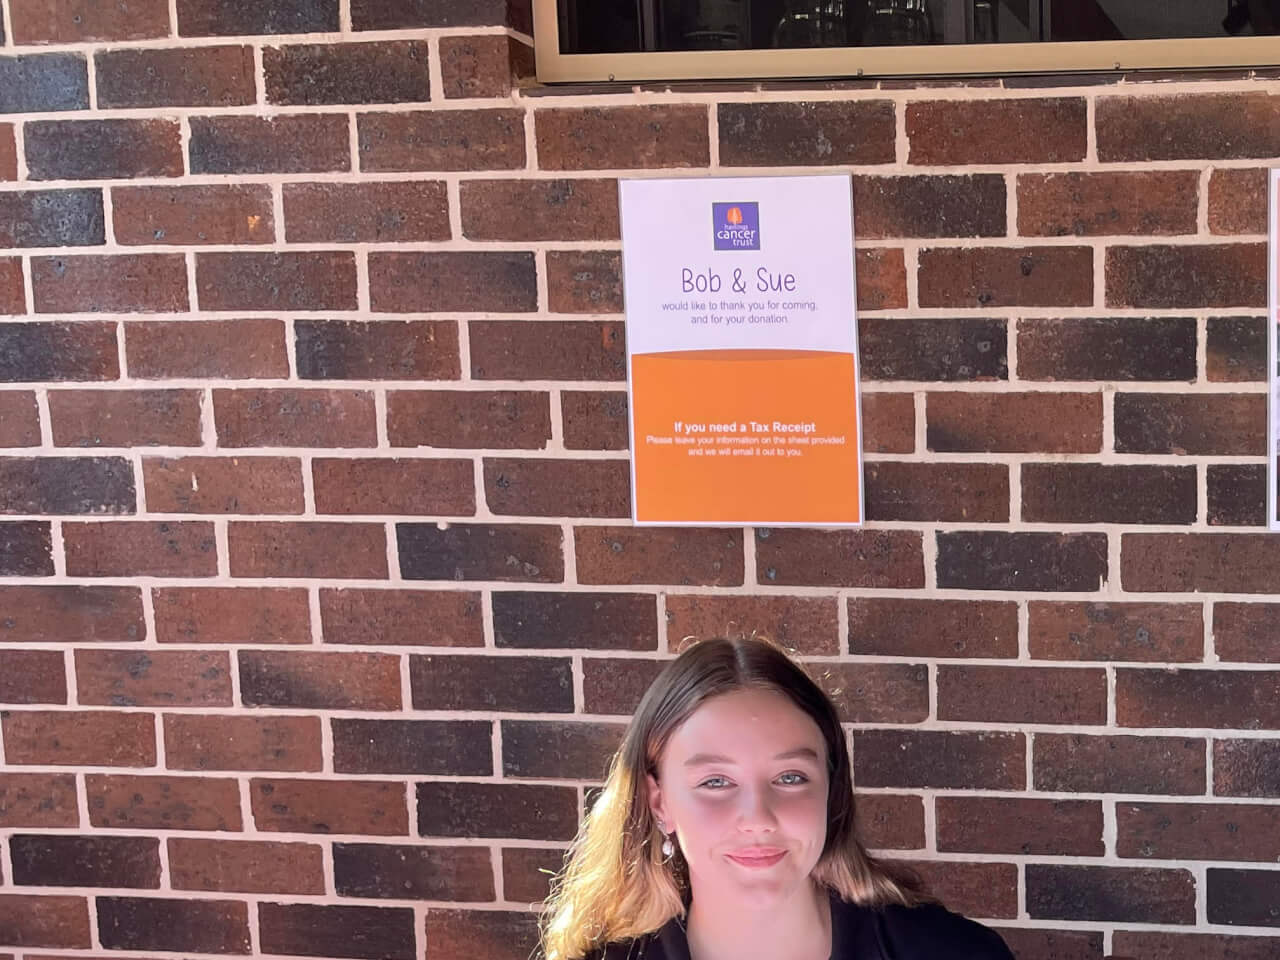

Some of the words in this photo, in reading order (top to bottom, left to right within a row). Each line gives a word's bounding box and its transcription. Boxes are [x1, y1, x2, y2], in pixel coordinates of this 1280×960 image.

[717, 229, 756, 240] cancer
[733, 239, 754, 247] trust
[682, 267, 722, 293] Bob
[732, 268, 746, 294] &
[757, 266, 796, 293] Sue
[662, 301, 688, 311] would
[691, 301, 706, 310] like
[708, 301, 718, 310] to
[720, 300, 745, 310] thank
[748, 302, 765, 312] you
[767, 300, 780, 310] for
[690, 315, 708, 325] and
[710, 314, 724, 324] for
[726, 316, 746, 326] your
[674, 421, 682, 433] If
[684, 423, 706, 435] you
[709, 421, 737, 433] need
[740, 423, 747, 433] a
[749, 421, 770, 433] Tax
[772, 421, 817, 435] Receipt
